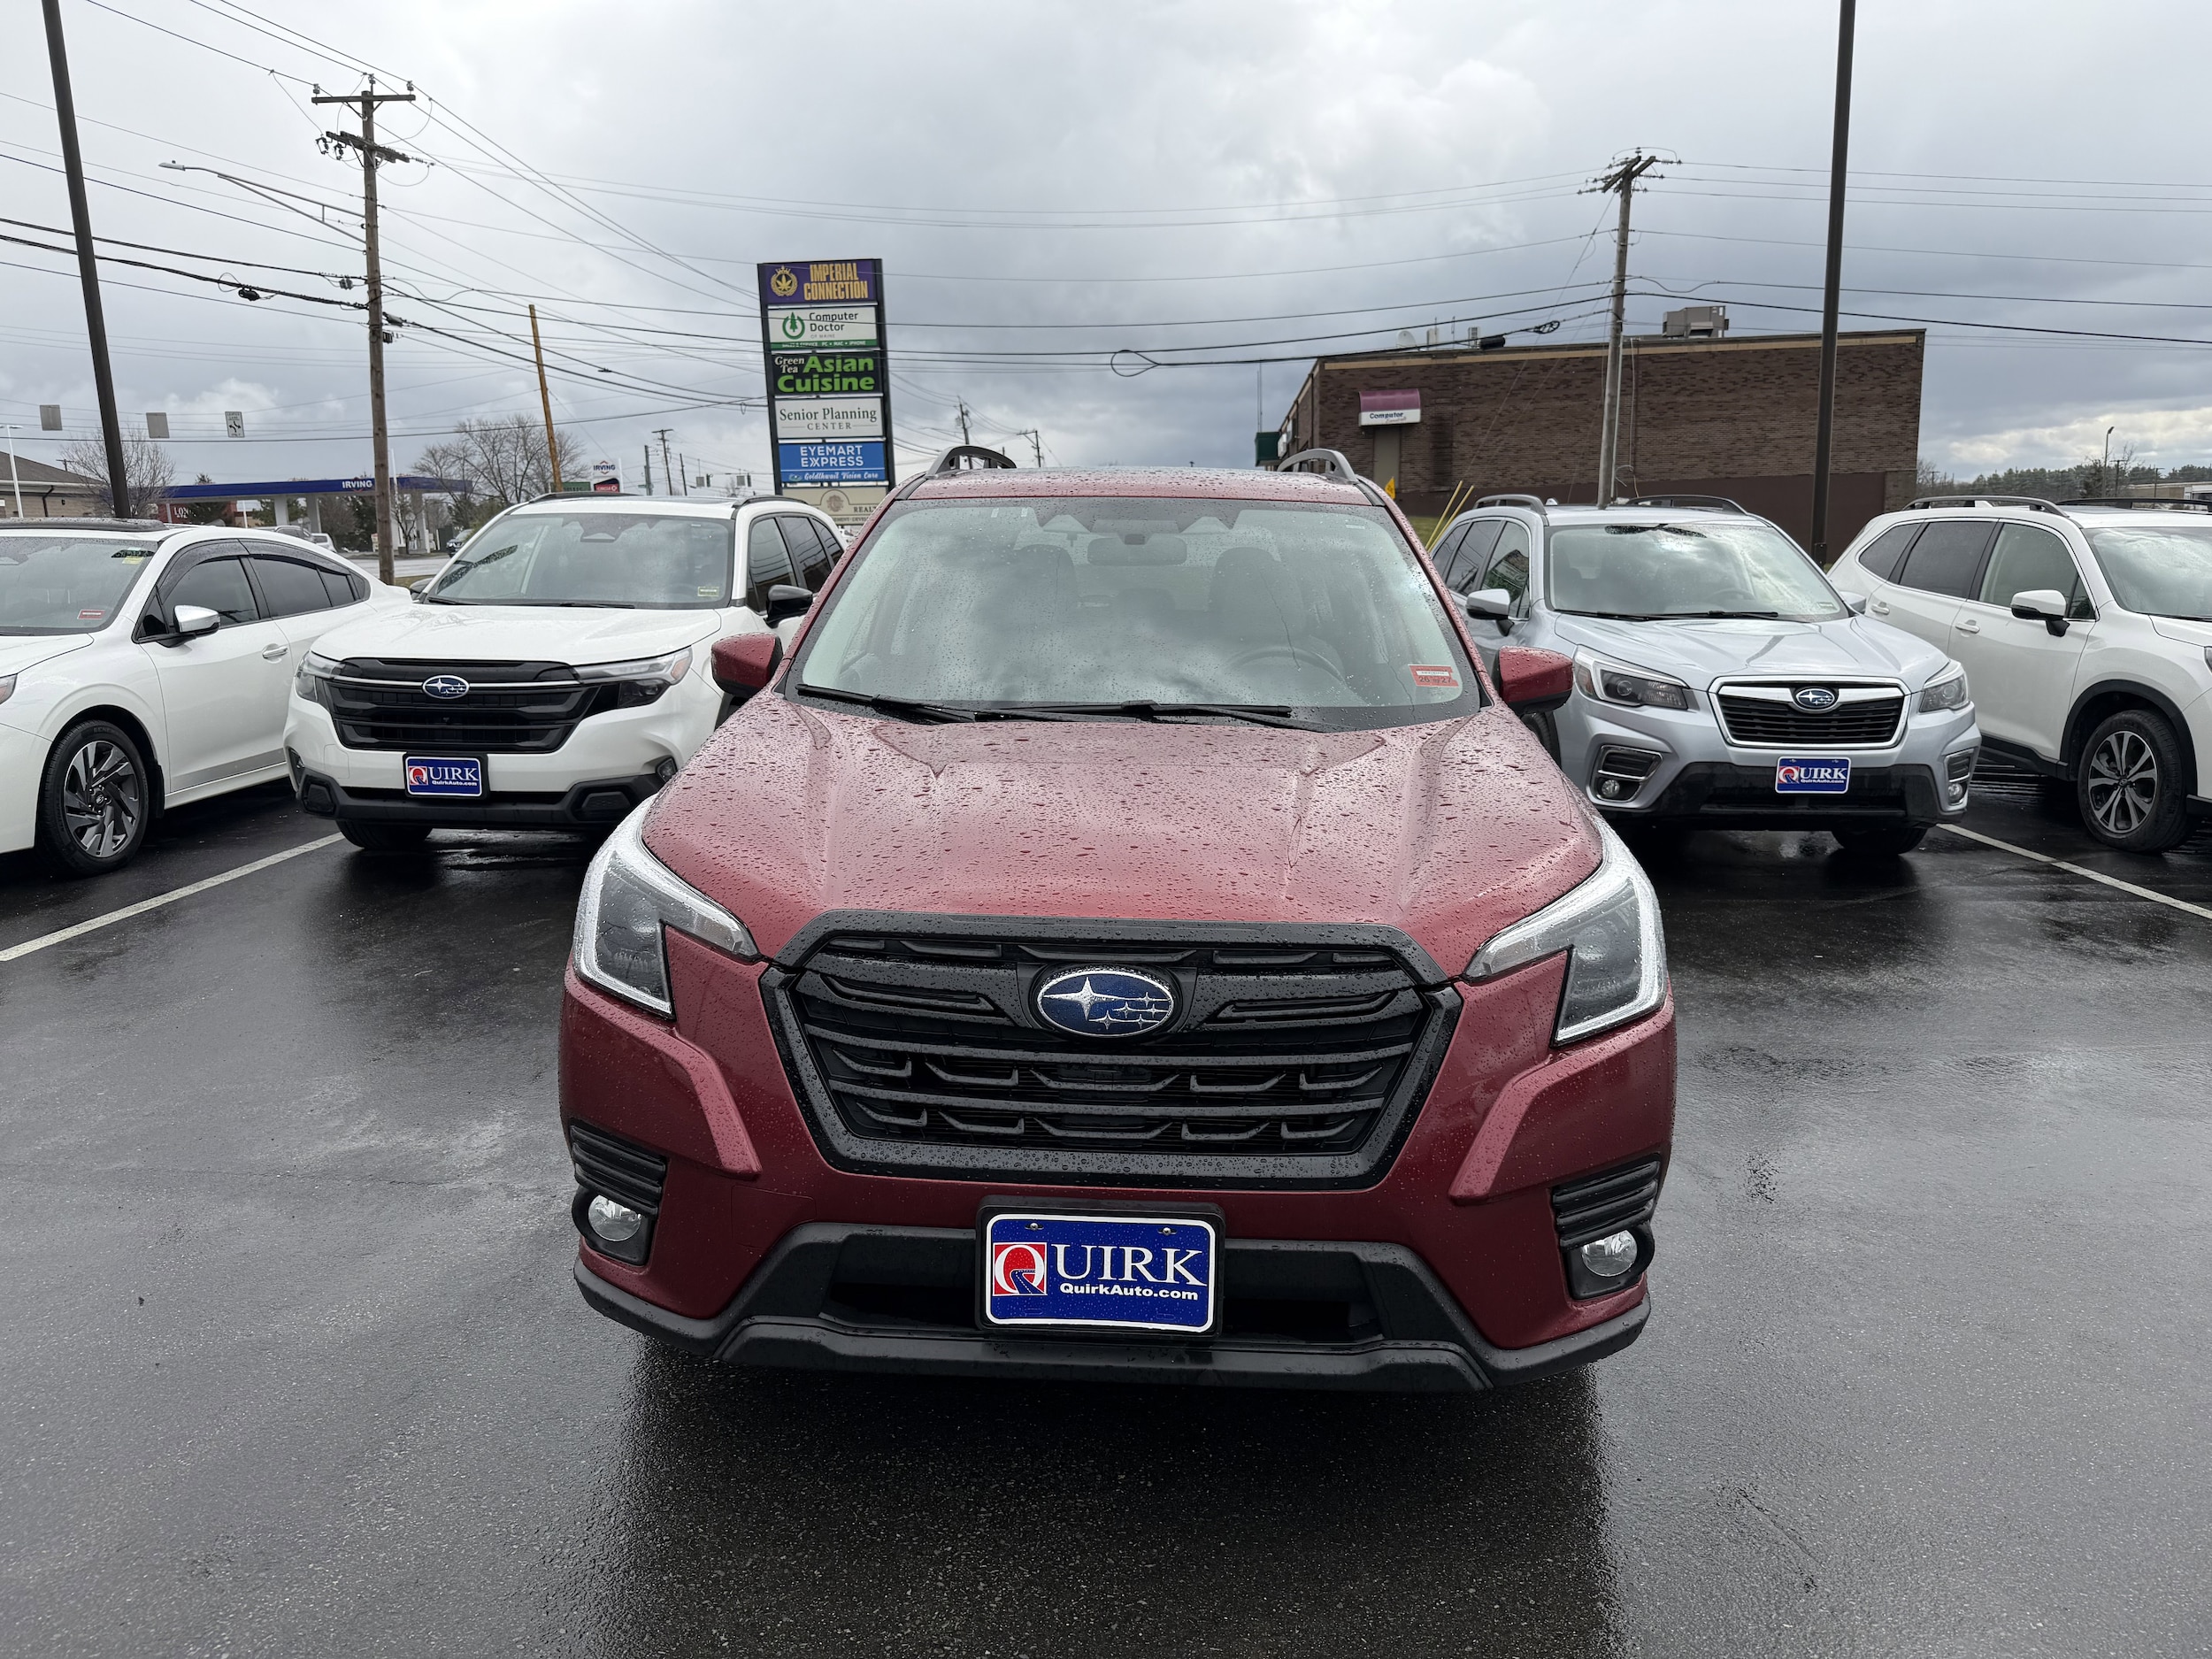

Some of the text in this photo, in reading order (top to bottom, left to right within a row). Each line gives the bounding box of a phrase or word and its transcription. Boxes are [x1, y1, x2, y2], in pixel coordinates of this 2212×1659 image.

[810, 263, 859, 282] IMPERIAL
[803, 280, 868, 301] CONNECTION
[809, 311, 858, 324] Computer
[810, 322, 845, 332] Doctor
[774, 356, 805, 365] Green
[803, 355, 874, 373] Asian
[780, 364, 799, 374] Tea
[777, 373, 875, 393] Cuisine
[780, 407, 878, 422] Senior Planning
[807, 422, 852, 431] CENTER
[800, 445, 863, 457] EYEMART
[342, 480, 373, 489] IRVING
[409, 766, 479, 785] QUIRK
[1778, 766, 1847, 783] QUIRK
[994, 1242, 1208, 1295] QUIRK
[1059, 1282, 1199, 1301] QuirkAuto.com
